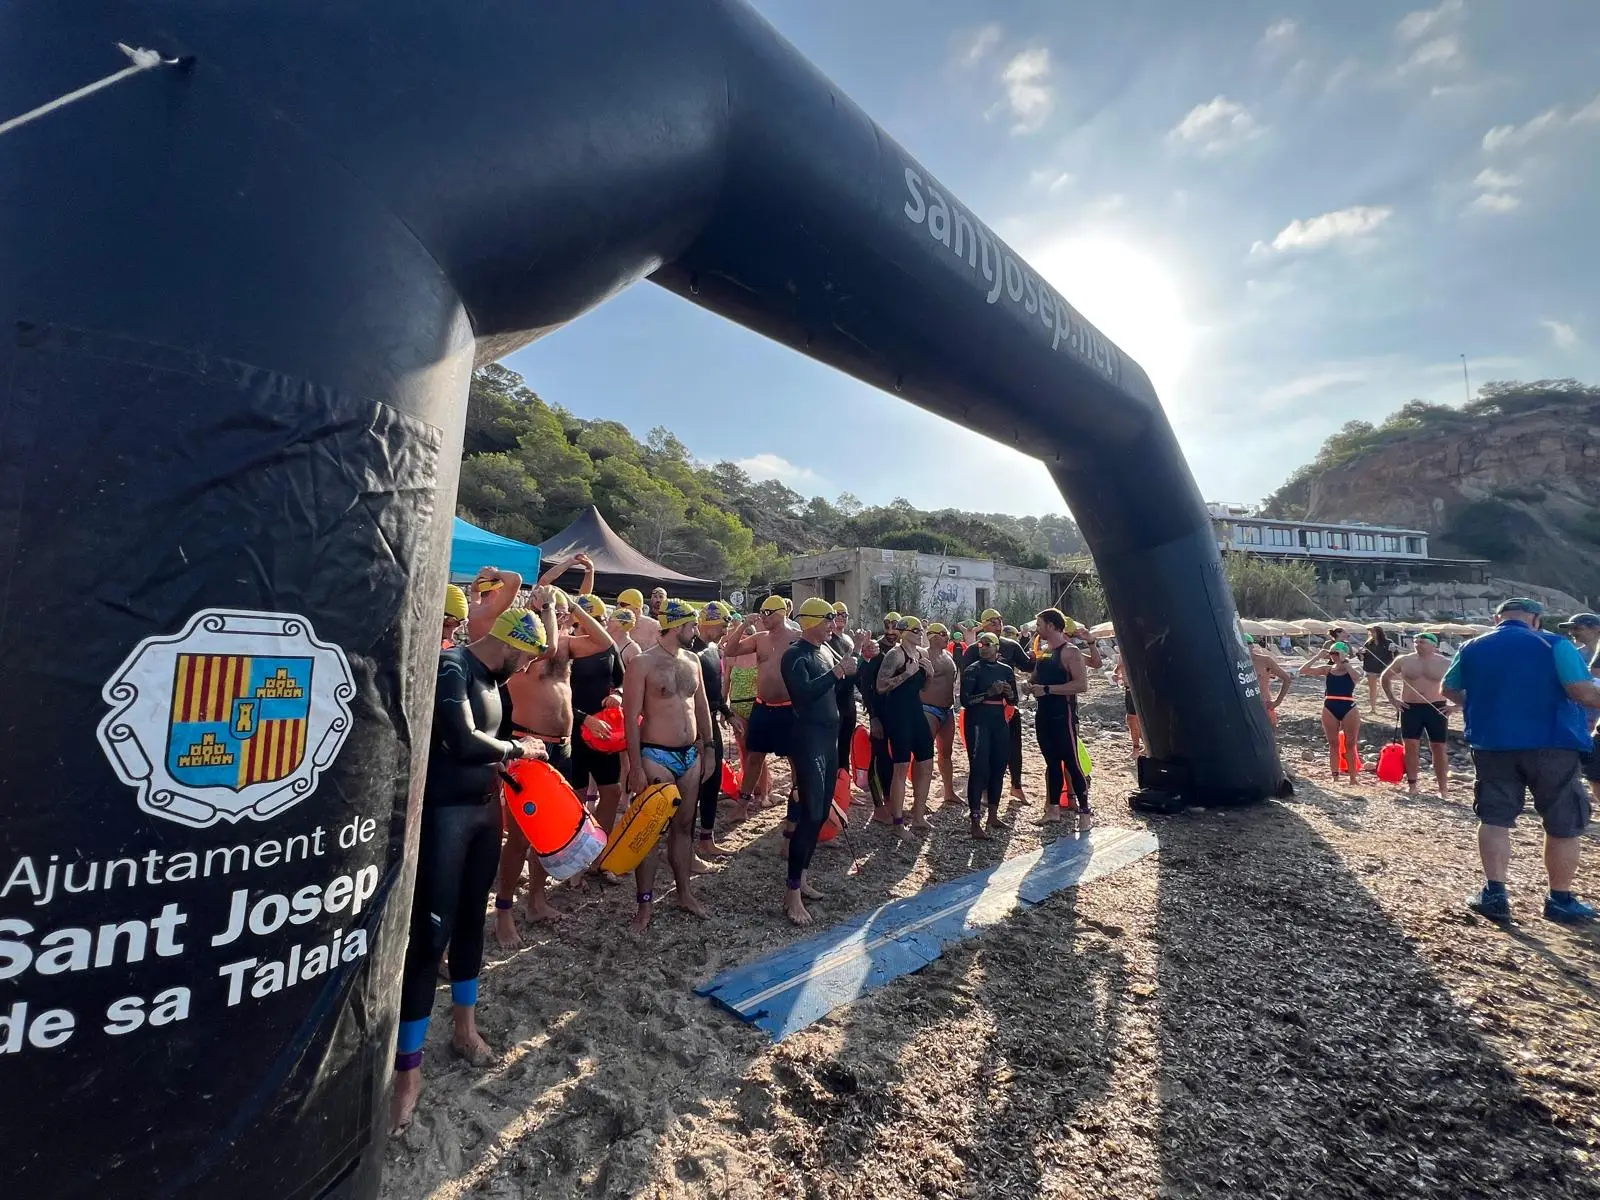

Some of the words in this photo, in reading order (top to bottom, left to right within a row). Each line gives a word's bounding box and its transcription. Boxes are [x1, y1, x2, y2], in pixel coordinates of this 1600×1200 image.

[904, 167, 1113, 376] santjosep.net
[0, 826, 325, 905] Ajuntament
[338, 815, 377, 850] de
[0, 902, 188, 980] Sant
[211, 863, 380, 948] Josep
[0, 1001, 76, 1055] de
[103, 985, 192, 1036] sa
[218, 928, 367, 1007] Talaia
